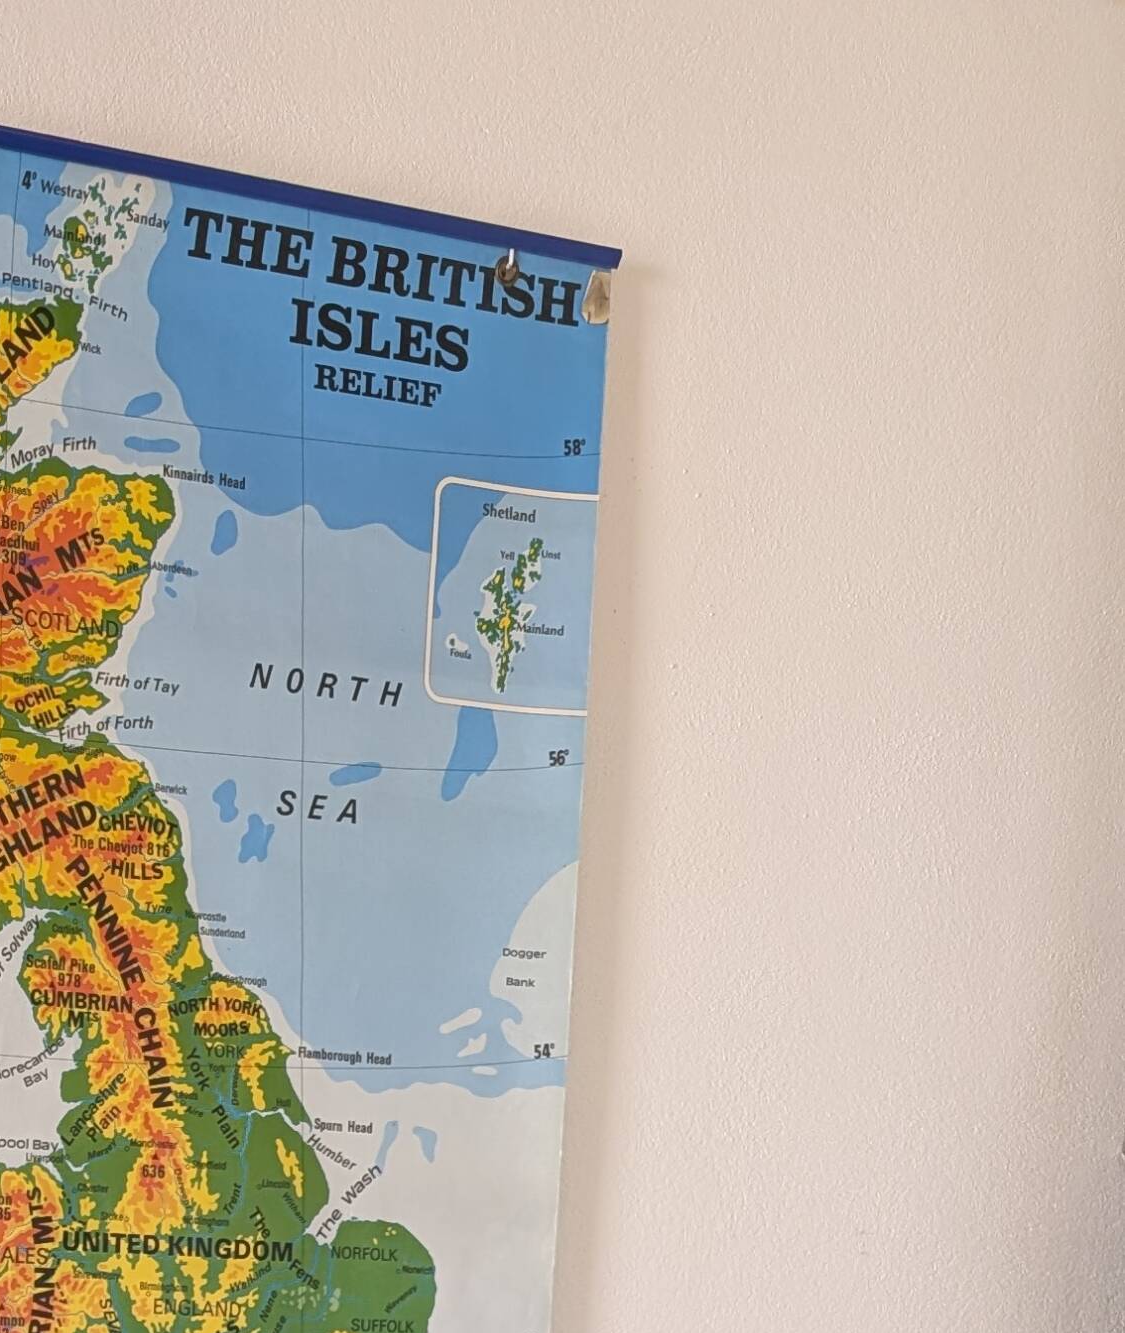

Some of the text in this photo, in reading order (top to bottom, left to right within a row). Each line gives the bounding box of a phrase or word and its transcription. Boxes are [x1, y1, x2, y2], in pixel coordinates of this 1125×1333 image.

[41, 179, 90, 204] Westray
[126, 209, 169, 231] Sanday
[184, 207, 582, 327] THE BRITISH
[2, 272, 128, 322] Pentland Firth
[289, 298, 469, 373] ISLES
[314, 363, 443, 408] RELIEF
[10, 437, 96, 468] Moray Firth
[163, 465, 246, 491] Kinnairds Head
[483, 503, 536, 523] Shetland
[55, 528, 105, 572] MTS
[541, 549, 561, 560] Unst
[12, 607, 120, 638] SCOTLAND
[449, 647, 472, 660] Foula
[95, 672, 180, 697] Firth of Tay
[249, 662, 404, 707] NORTH
[59, 716, 154, 742] Firth of Forth
[276, 789, 359, 824] SEA
[99, 814, 178, 843] CHEVIOT
[109, 858, 164, 881] HILLS
[502, 948, 547, 961] Dogger
[63, 853, 146, 992] PENNINE
[134, 1007, 174, 1110] CHAIN
[506, 977, 536, 988] Bank
[31, 988, 133, 1014] CUMBRIAN
[298, 1046, 392, 1065] Flamborough Head
[23, 1068, 49, 1088] Bay
[314, 1118, 373, 1135] Spurn Head
[32, 1139, 59, 1152] Bay
[307, 1134, 357, 1171] Humber
[316, 1164, 383, 1240] The Wash
[27, 1187, 56, 1245] MTS
[62, 1232, 294, 1263] UNITED KINGDOM
[331, 1245, 399, 1262] NORFOLK
[153, 1299, 241, 1318] ENGLAND
[351, 1319, 415, 1333] SUFFOLK
